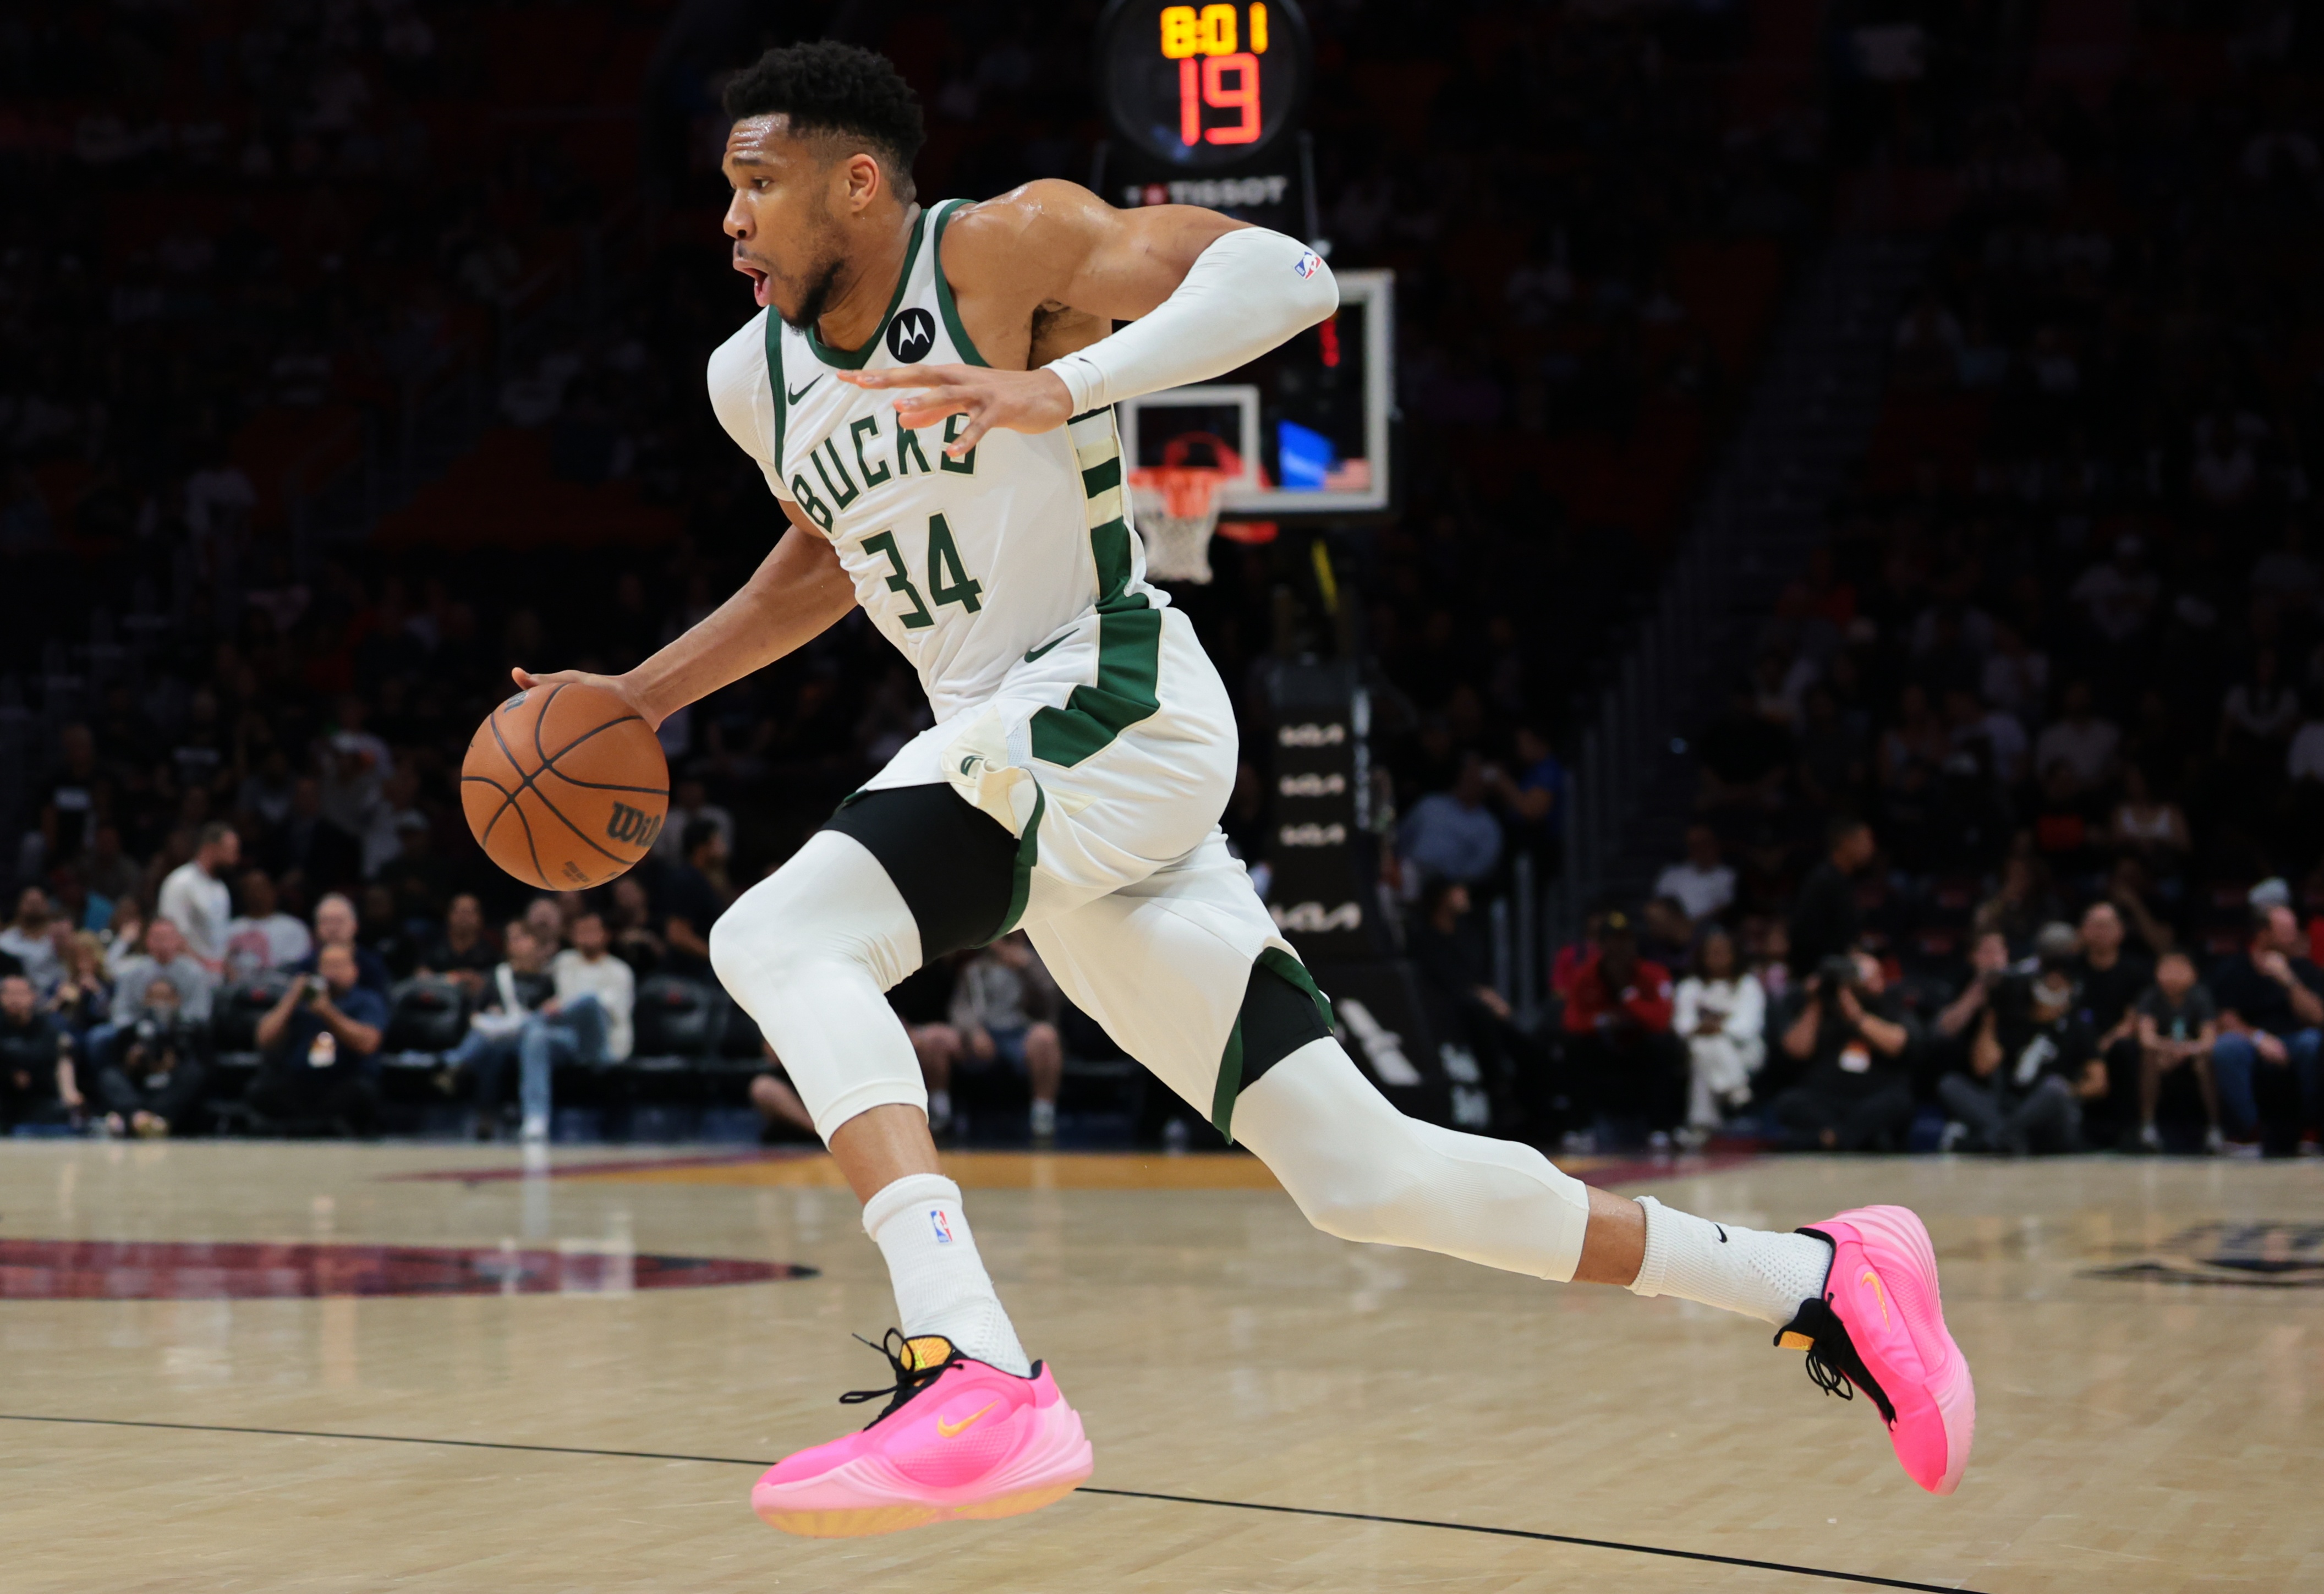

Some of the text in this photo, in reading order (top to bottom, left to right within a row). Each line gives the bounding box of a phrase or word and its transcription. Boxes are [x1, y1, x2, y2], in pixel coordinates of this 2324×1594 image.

[1160, 2, 1268, 58] 8:01
[1179, 52, 1261, 146] 19
[1169, 175, 1287, 206] TISSOT
[791, 412, 977, 535] BUCKS
[859, 511, 984, 631] 34
[607, 801, 661, 847] Wil
